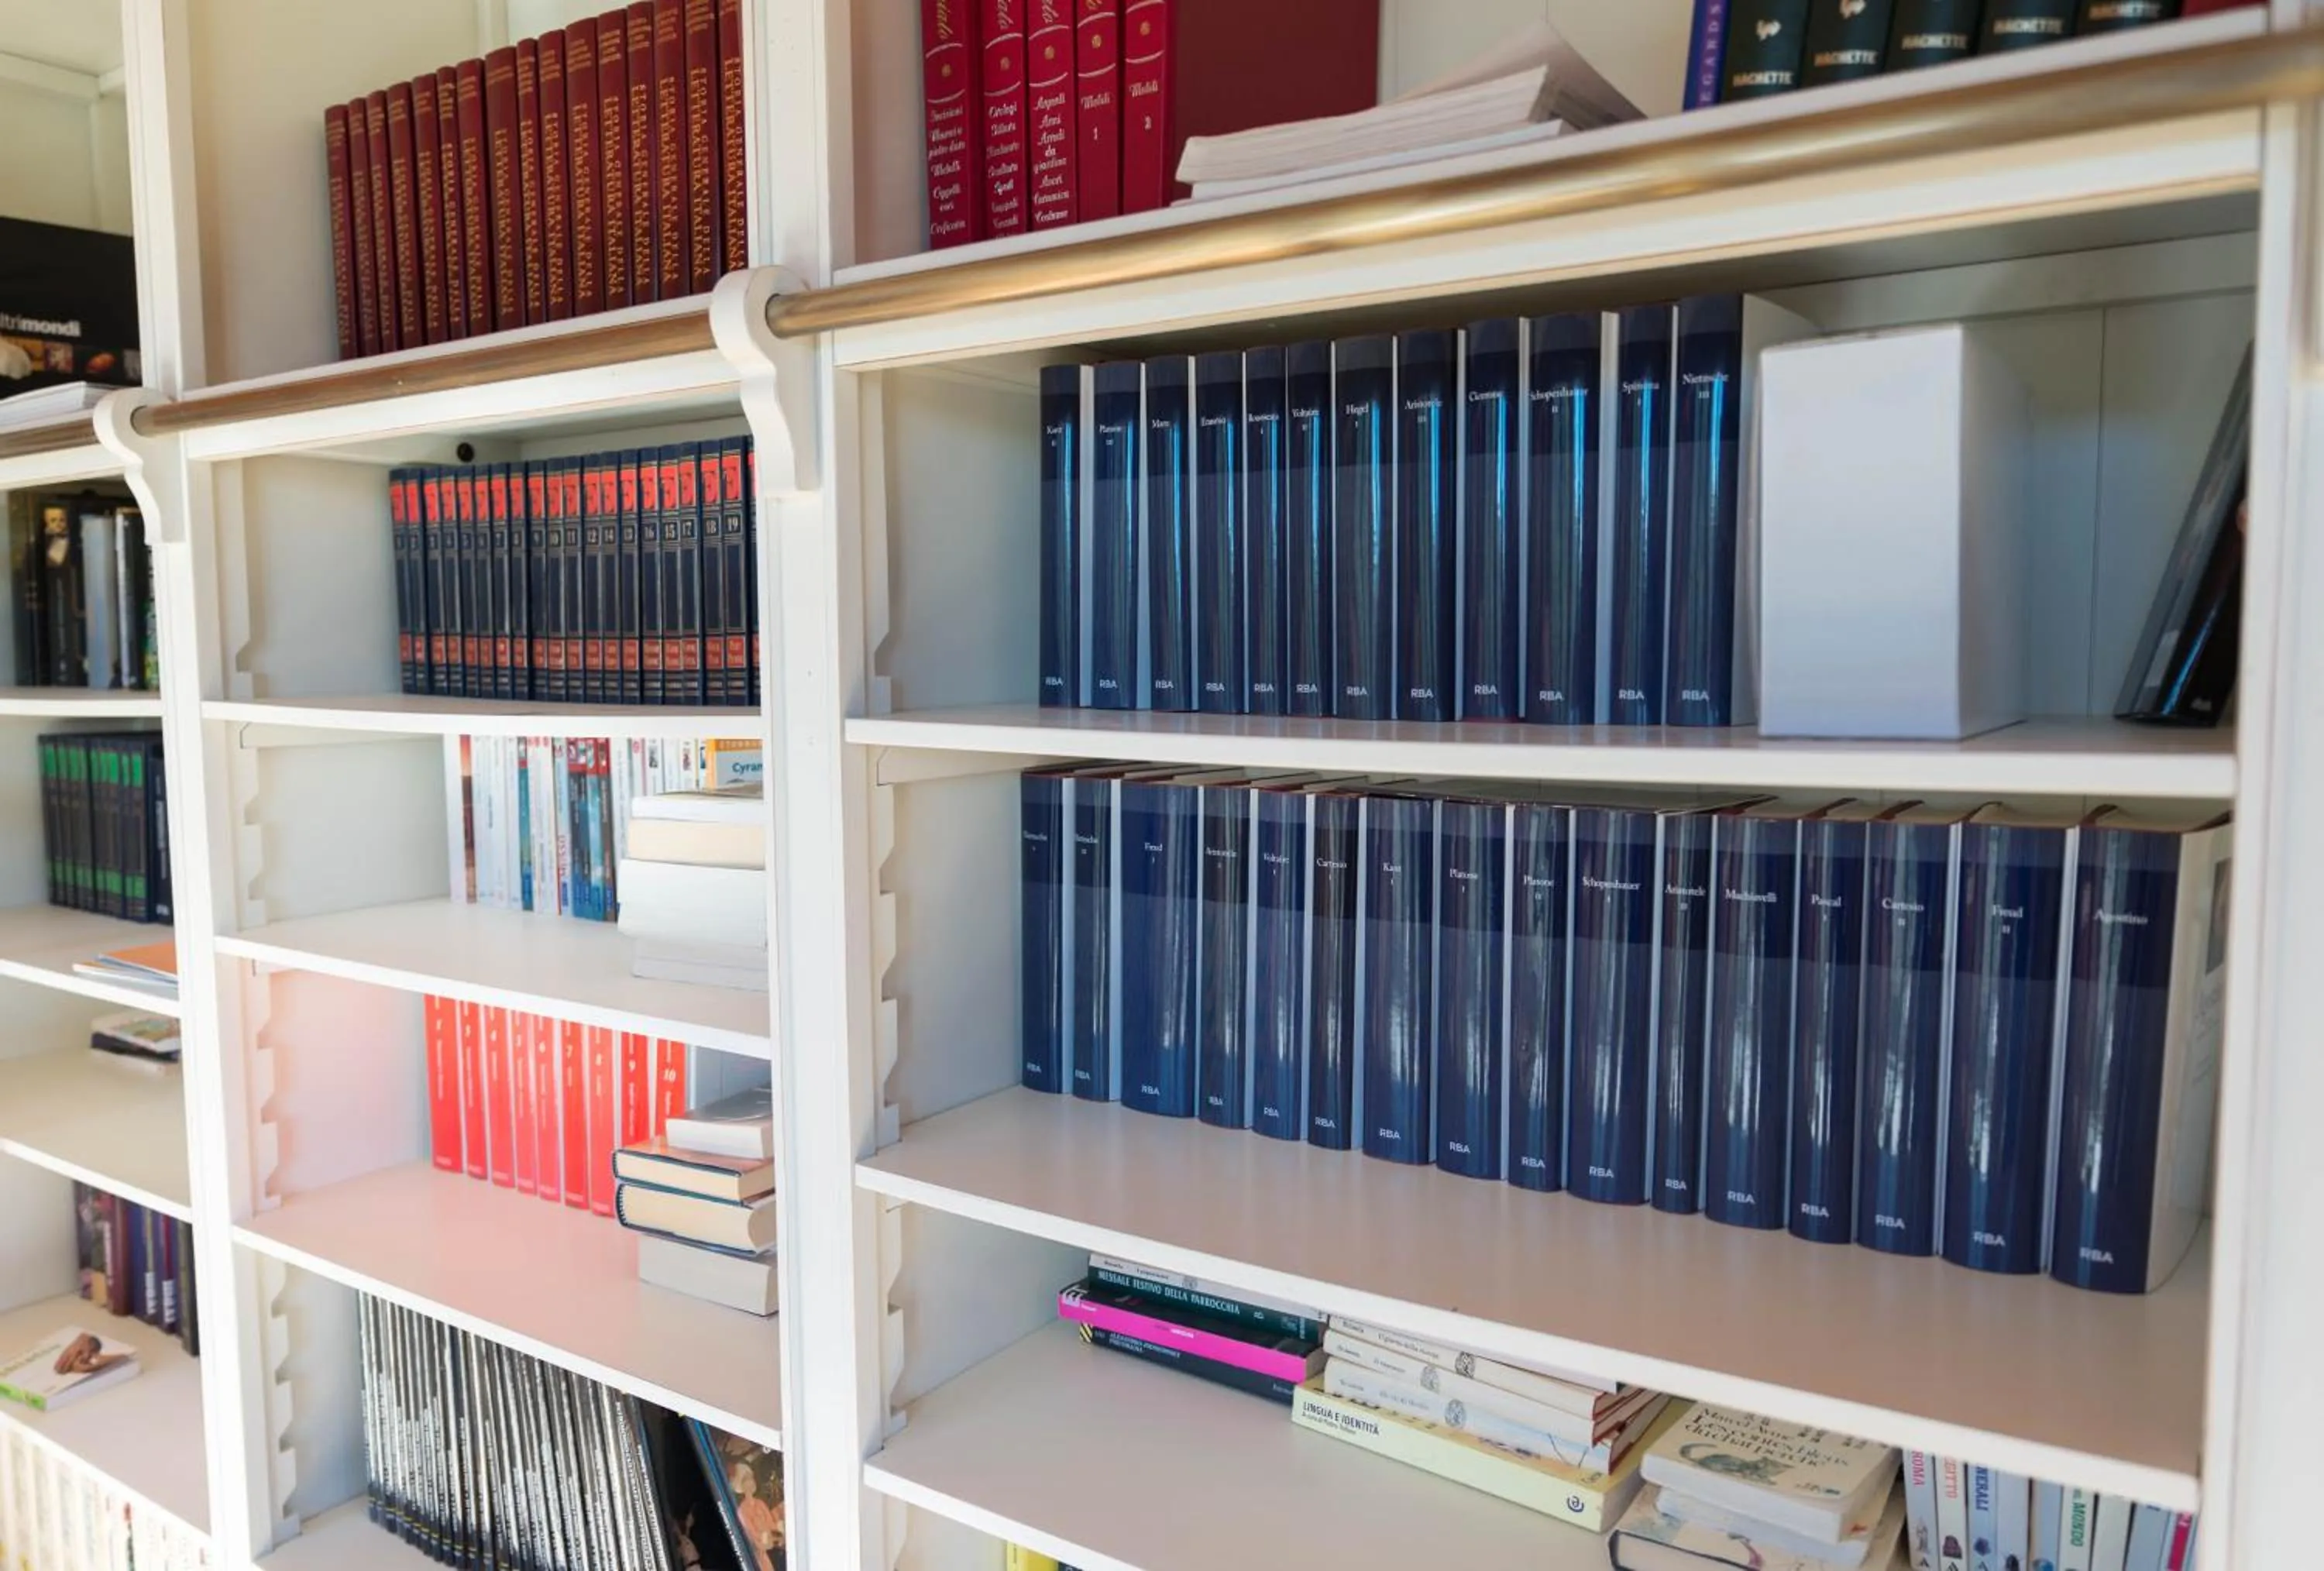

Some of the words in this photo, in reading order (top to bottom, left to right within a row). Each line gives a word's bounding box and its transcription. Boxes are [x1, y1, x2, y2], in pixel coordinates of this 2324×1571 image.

[1814, 50, 1878, 67] HACHETTE
[1733, 70, 1792, 87] HACHETTE
[699, 67, 707, 125] STORIA
[690, 68, 702, 191] LETTERATURA
[700, 135, 710, 215] GENERALE
[693, 197, 703, 277] ITALIANA
[702, 225, 710, 274] DELLA
[1346, 403, 1370, 416] Hegel
[682, 521, 692, 535] 17
[706, 521, 717, 534] 18
[728, 517, 738, 530] 19
[665, 524, 675, 538] 15
[1346, 686, 1367, 696] RBA
[1411, 688, 1434, 698] RBA
[1474, 684, 1497, 696] RBA
[1539, 691, 1563, 701] RBA
[1618, 689, 1644, 700] RBA
[1682, 689, 1710, 701] RBA
[1811, 894, 1841, 907] Pascal
[1882, 897, 1924, 912] Cartesio
[1992, 904, 2023, 918] Freud
[2093, 909, 2148, 925] Agostino
[628, 1060, 635, 1073] 9
[664, 1068, 676, 1082] 10
[1379, 1127, 1401, 1140] RBA
[1449, 1141, 1470, 1153] RBA
[1521, 1157, 1545, 1169] RBA
[1589, 1166, 1614, 1178] RBA
[1666, 1178, 1687, 1190] RBA
[1727, 1191, 1755, 1205] RBA
[1801, 1203, 1829, 1218] RBA
[1875, 1214, 1905, 1230] RBA
[1974, 1232, 2006, 1247] RBA
[2080, 1247, 2113, 1264] RBA
[1098, 1270, 1130, 1287] MESSALE
[1133, 1279, 1162, 1295] FESTIVO
[1164, 1287, 1188, 1302] DELLA
[1191, 1293, 1240, 1315] PARROCCHIA
[1303, 1401, 1332, 1419] LINGUA
[1335, 1412, 1340, 1421] E
[1341, 1413, 1380, 1435] IDENTITÀ
[1912, 1451, 1925, 1486] ROMA
[2071, 1502, 2086, 1547] MONDO
